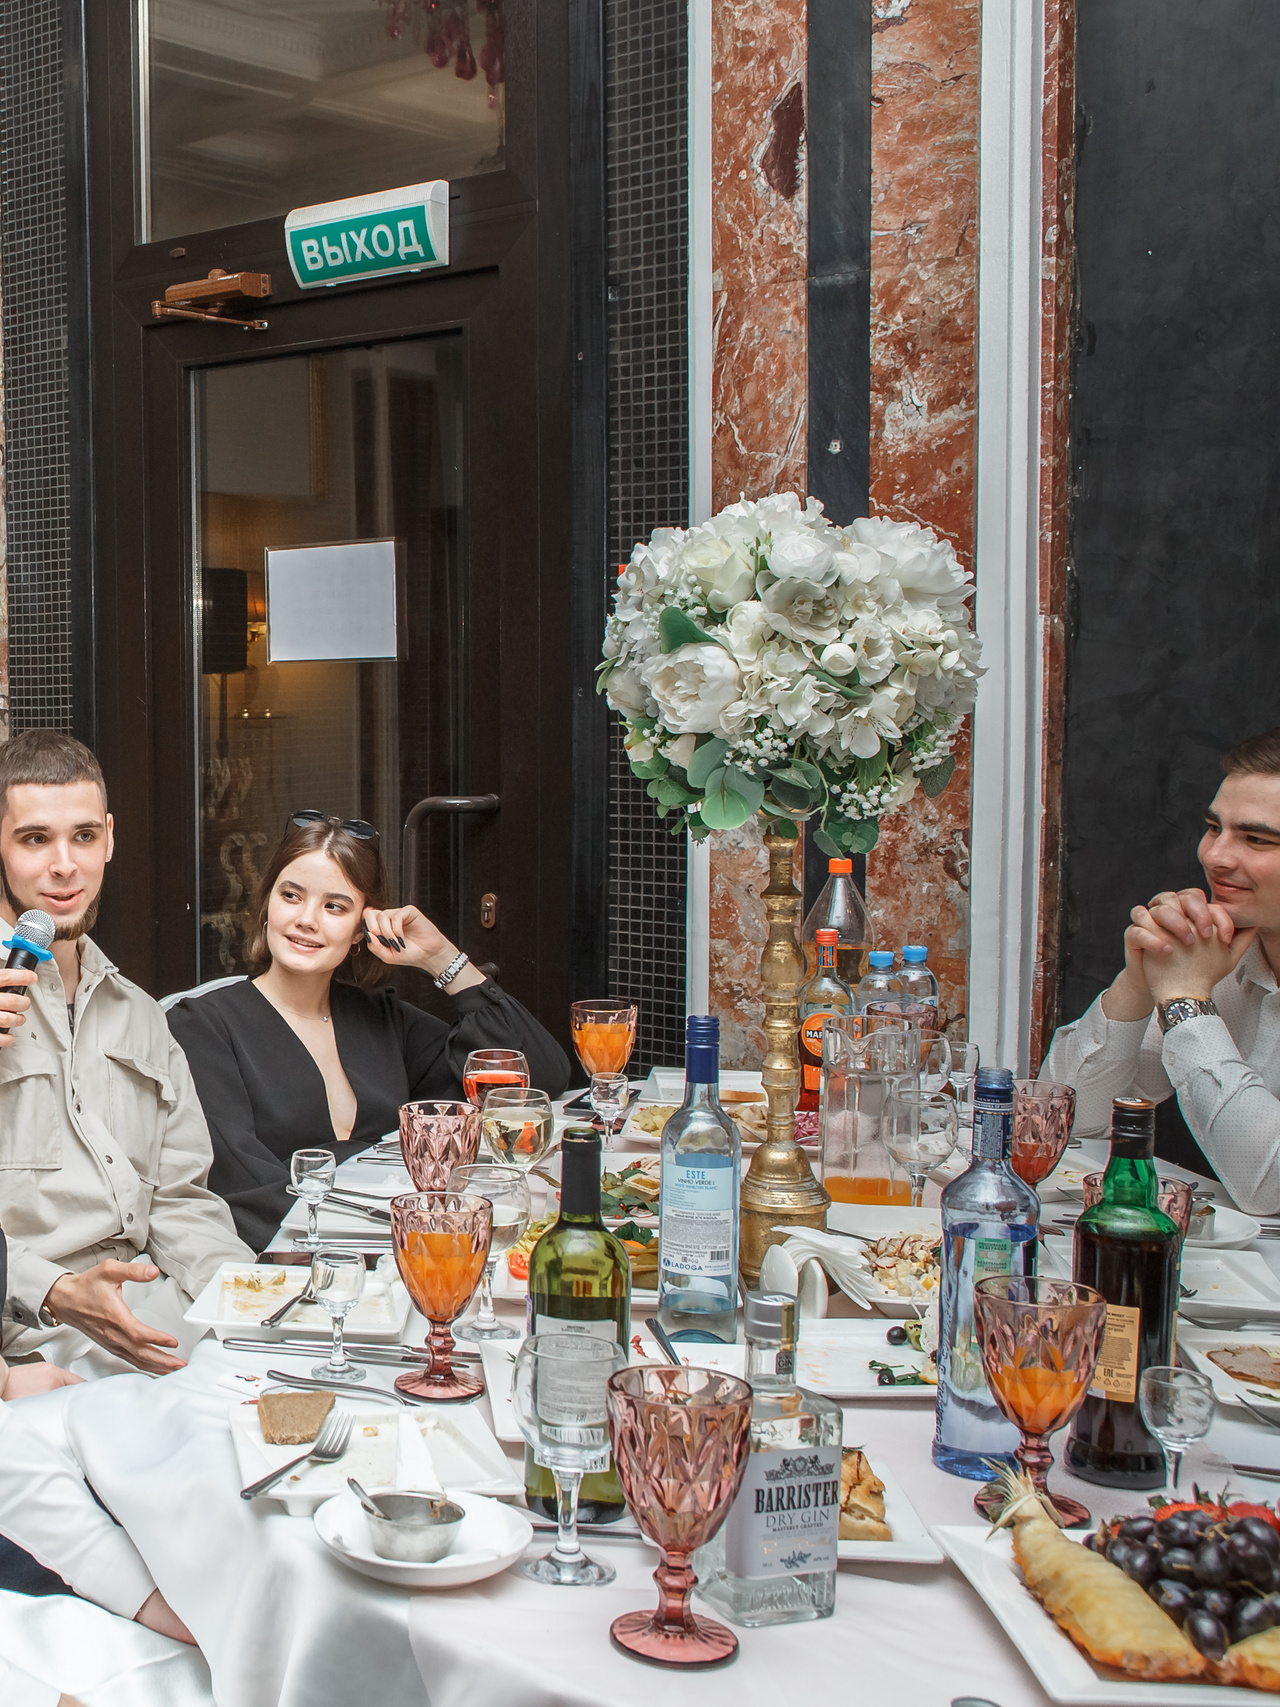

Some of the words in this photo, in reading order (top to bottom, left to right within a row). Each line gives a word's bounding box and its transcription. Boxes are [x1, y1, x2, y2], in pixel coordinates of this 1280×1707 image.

[301, 219, 425, 271] ВЫХОД
[686, 1170, 706, 1179] ESTE
[671, 1261, 703, 1271] LADOGA
[754, 1480, 839, 1514] BARRISTER
[765, 1513, 796, 1528] DRY
[801, 1508, 830, 1524] GIN
